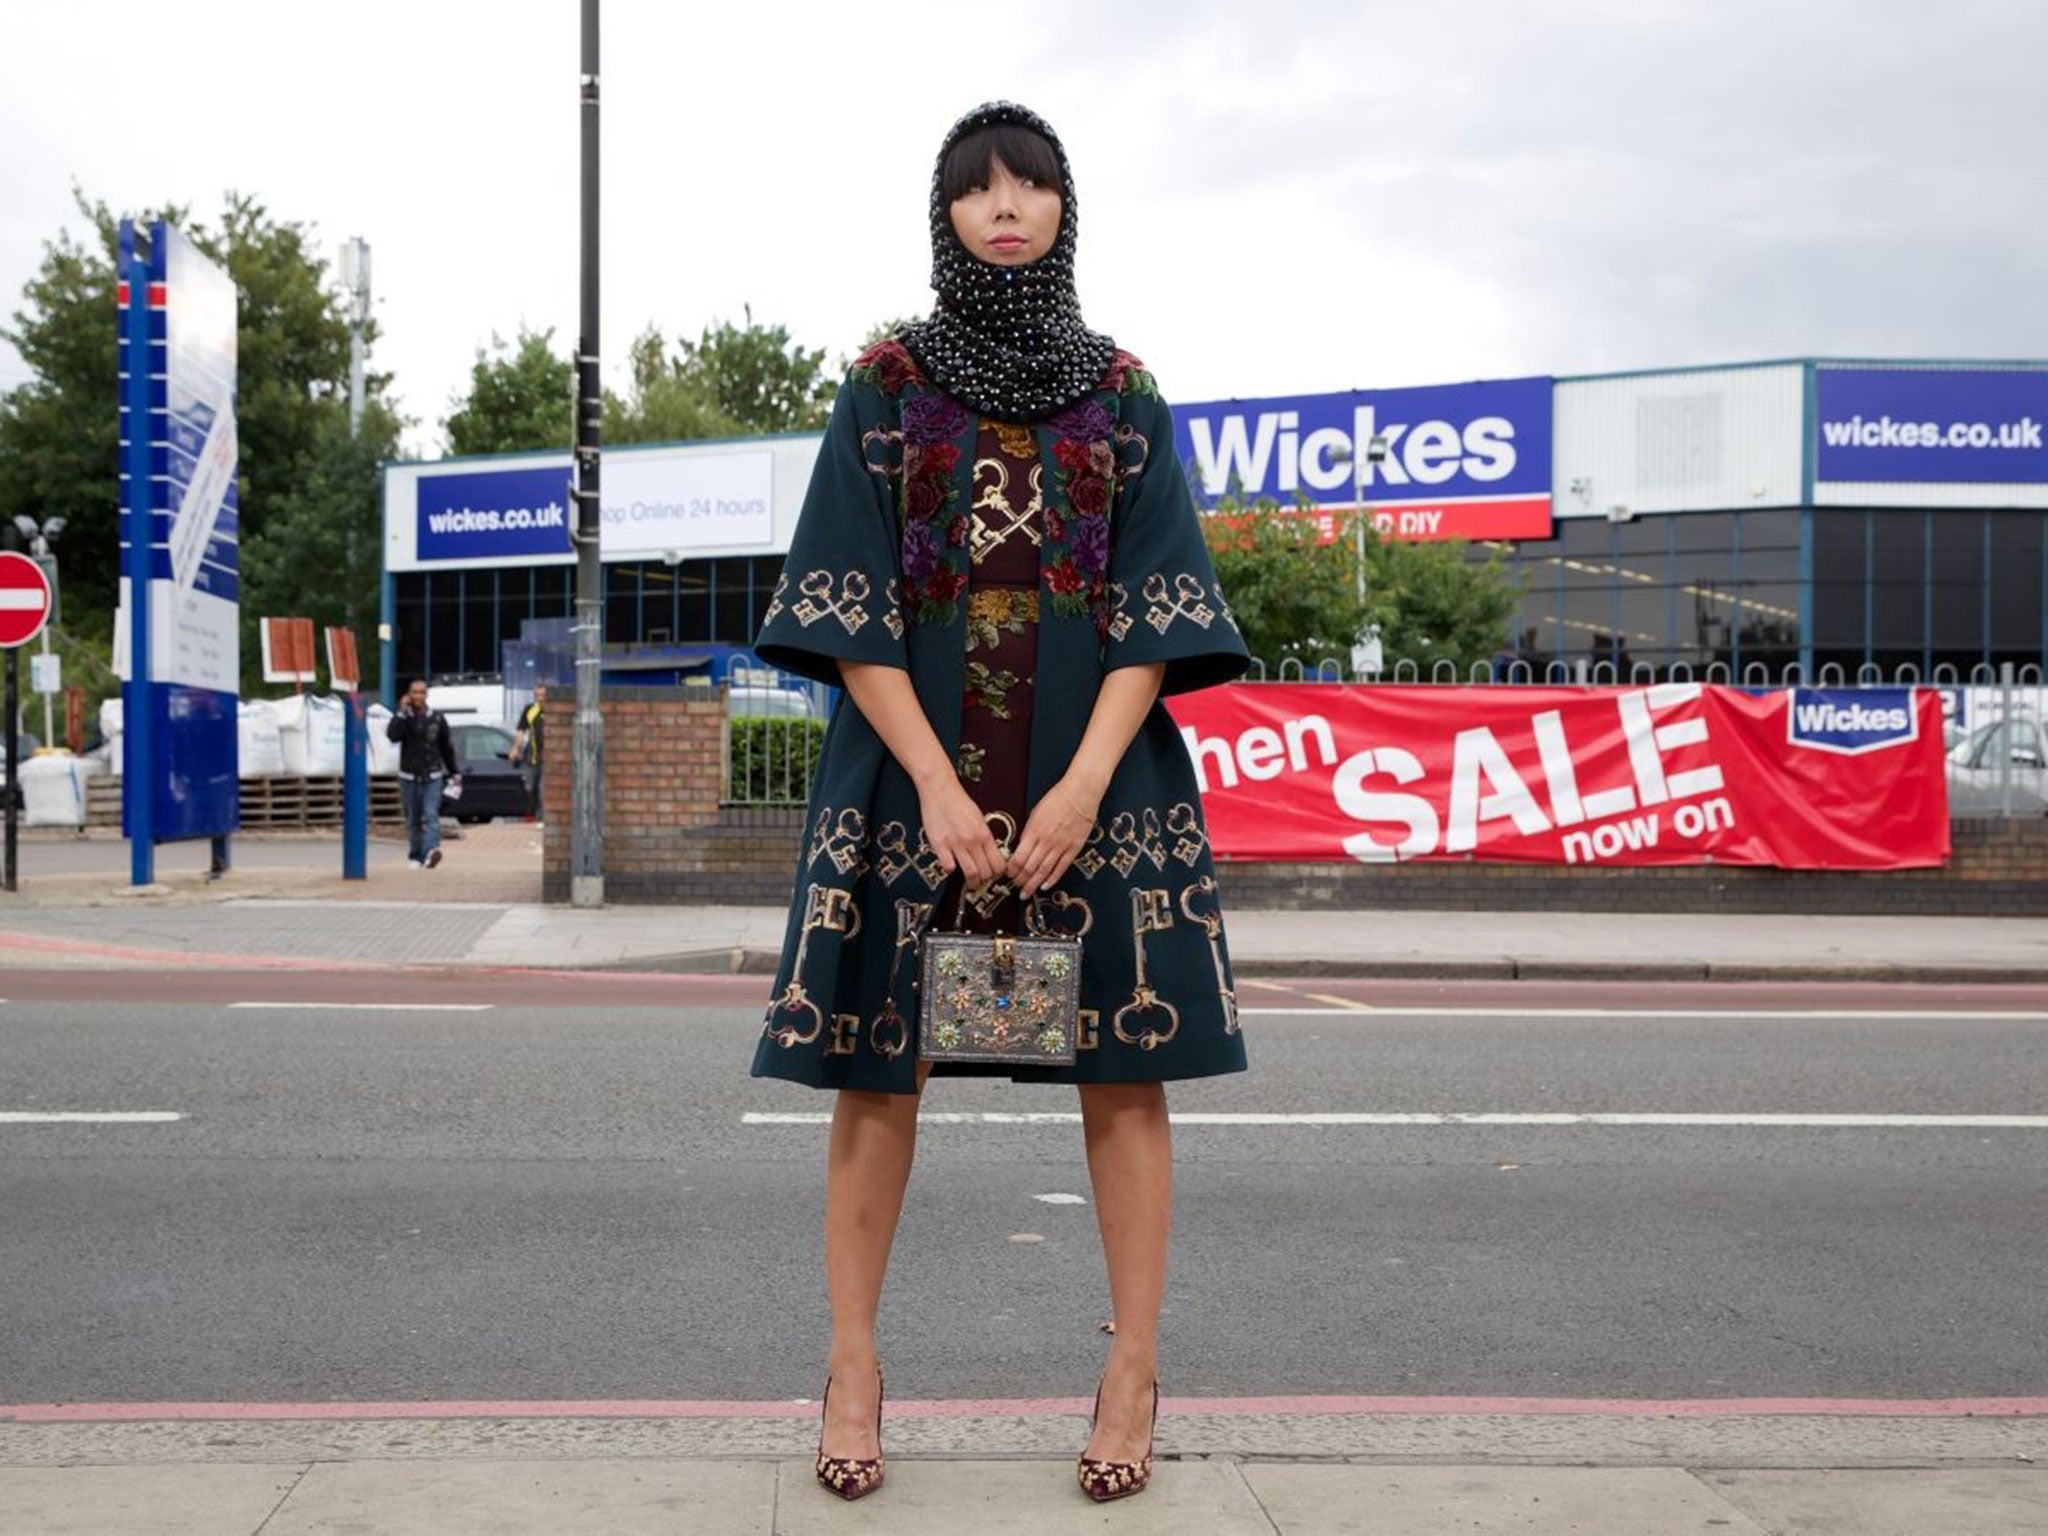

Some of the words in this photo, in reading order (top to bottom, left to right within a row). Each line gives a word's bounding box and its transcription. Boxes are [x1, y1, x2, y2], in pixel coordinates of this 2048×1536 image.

[1823, 415, 2043, 448] wickes.co.uk
[1188, 405, 1517, 495] Wickes
[428, 502, 564, 534] wickes.co.uk
[600, 506, 626, 523] hop
[630, 502, 685, 521] Online
[689, 500, 711, 518] 24
[716, 498, 766, 516] hours
[1399, 511, 1443, 535] DIY
[1797, 704, 1908, 733] Wickes
[1180, 714, 1339, 794] hen
[1331, 682, 1725, 864] SALE
[1562, 814, 1659, 864] now
[1673, 797, 1736, 838] on
